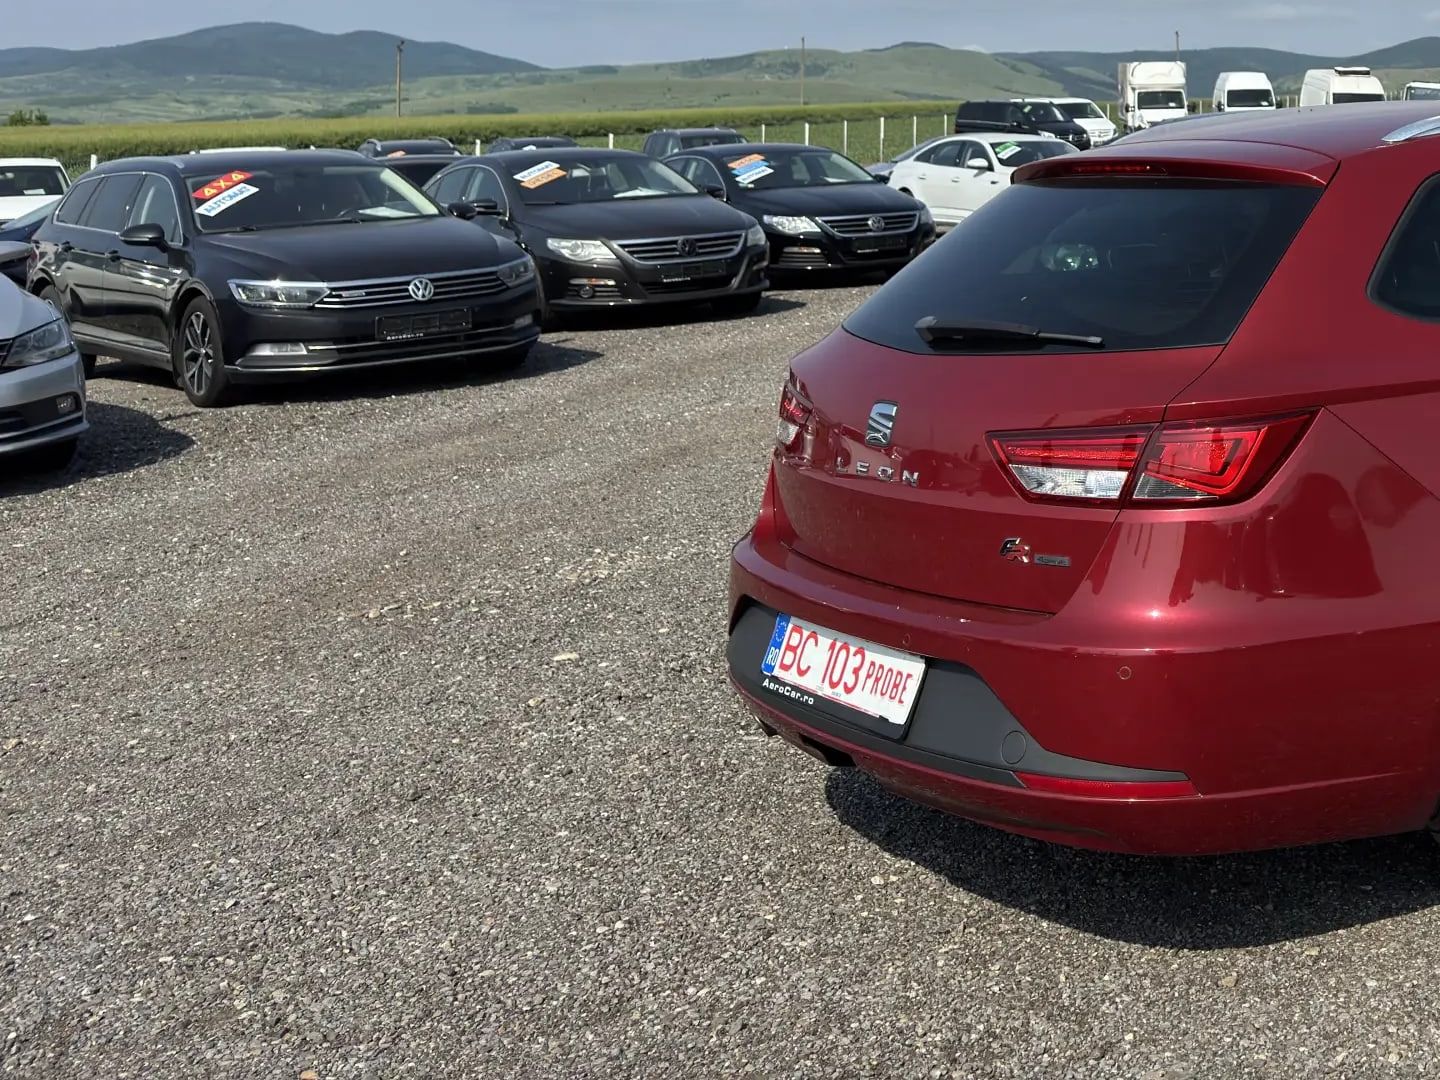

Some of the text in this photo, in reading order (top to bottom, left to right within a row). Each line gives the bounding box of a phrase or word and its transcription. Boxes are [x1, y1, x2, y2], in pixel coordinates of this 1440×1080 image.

[835, 456, 919, 487] LEON
[765, 624, 914, 705] RO BC 103 PROBE
[761, 677, 815, 705] AeroCar.ro
